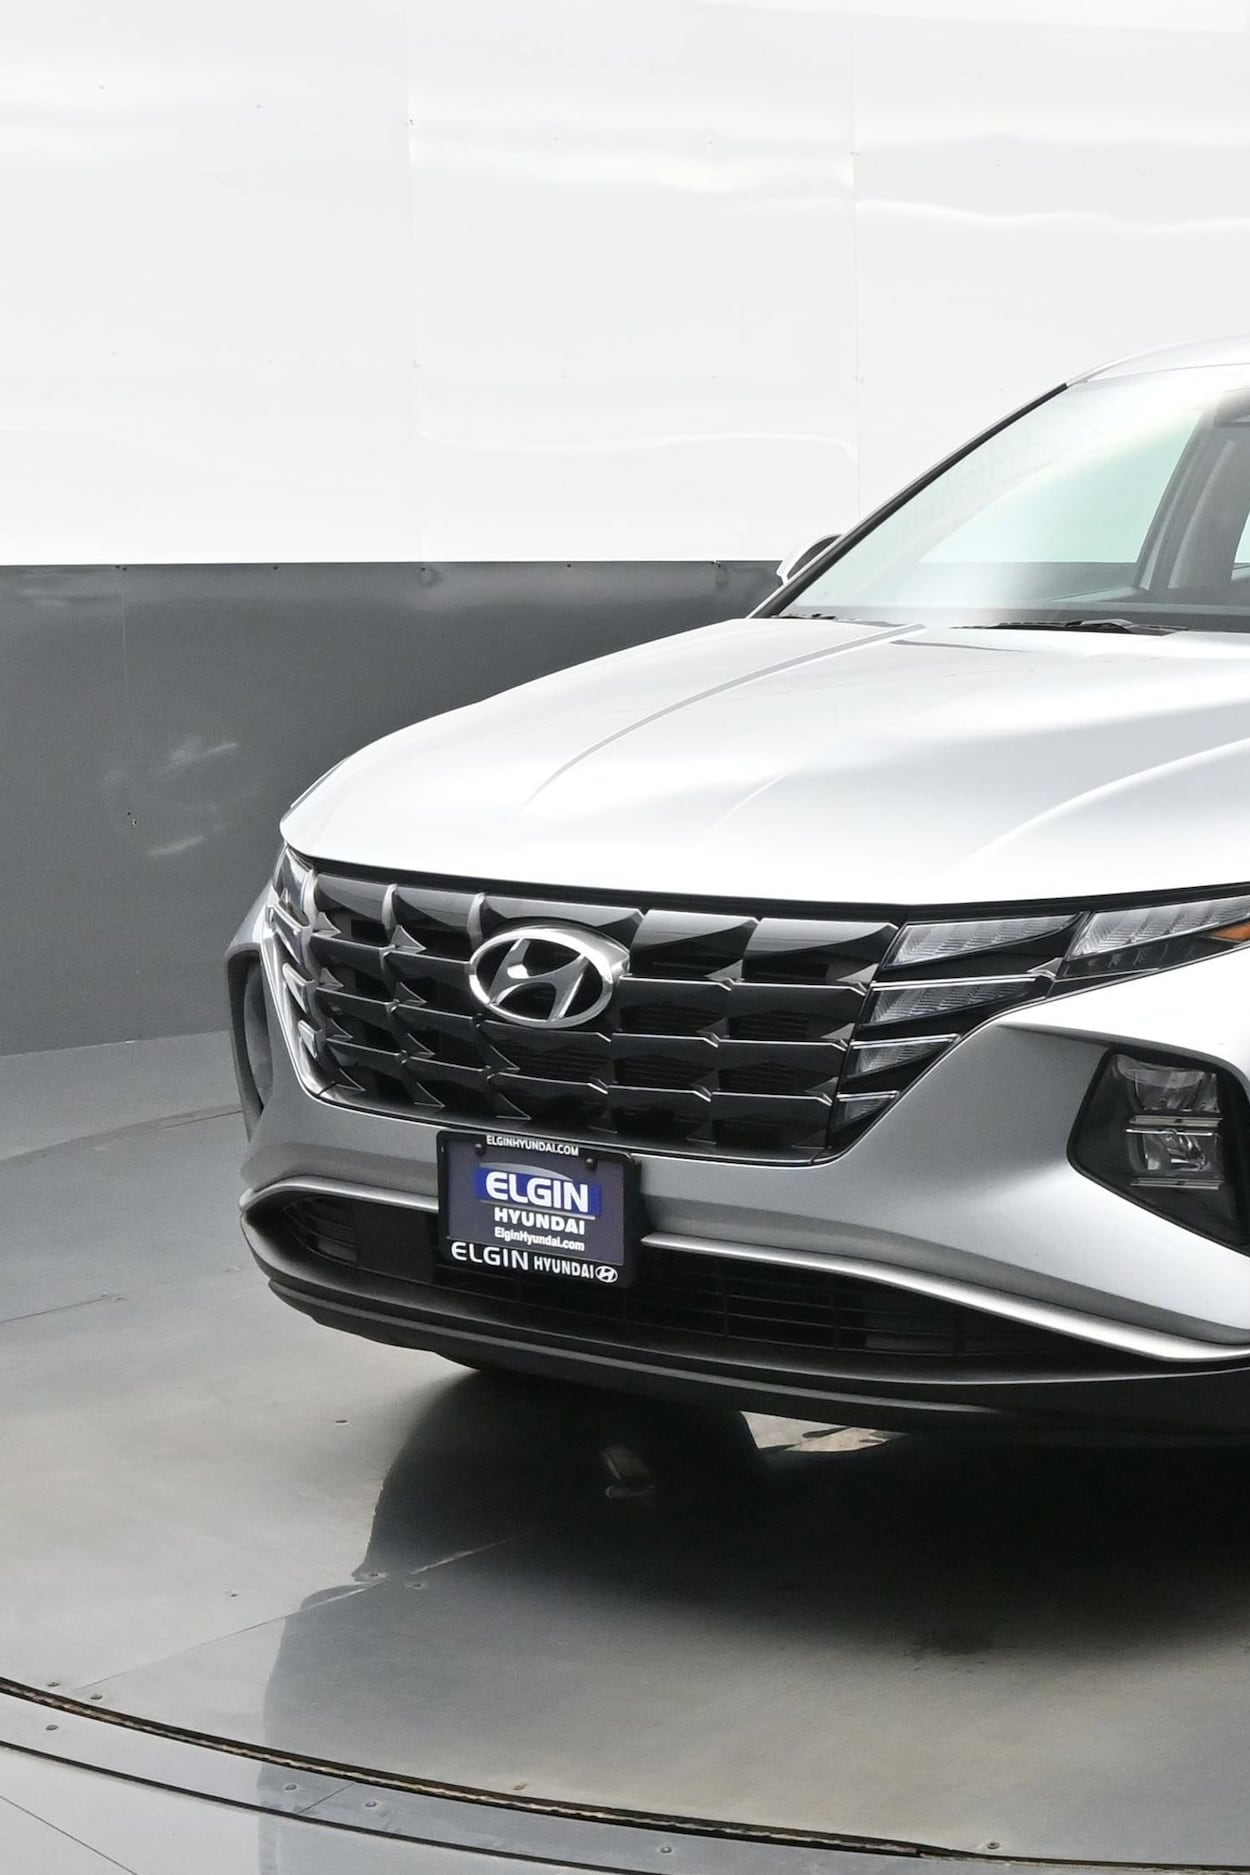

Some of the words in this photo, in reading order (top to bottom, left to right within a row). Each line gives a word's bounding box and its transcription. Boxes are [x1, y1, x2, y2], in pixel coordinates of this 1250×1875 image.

[486, 1135, 579, 1156] ELGINHYUNDAI.COM
[486, 1171, 588, 1213] ELGIN
[494, 1207, 585, 1235] HYUNDAI
[494, 1227, 585, 1251] ElginHyundai.com
[451, 1241, 529, 1270] ELGIN
[534, 1256, 594, 1279] HYUNDAI
